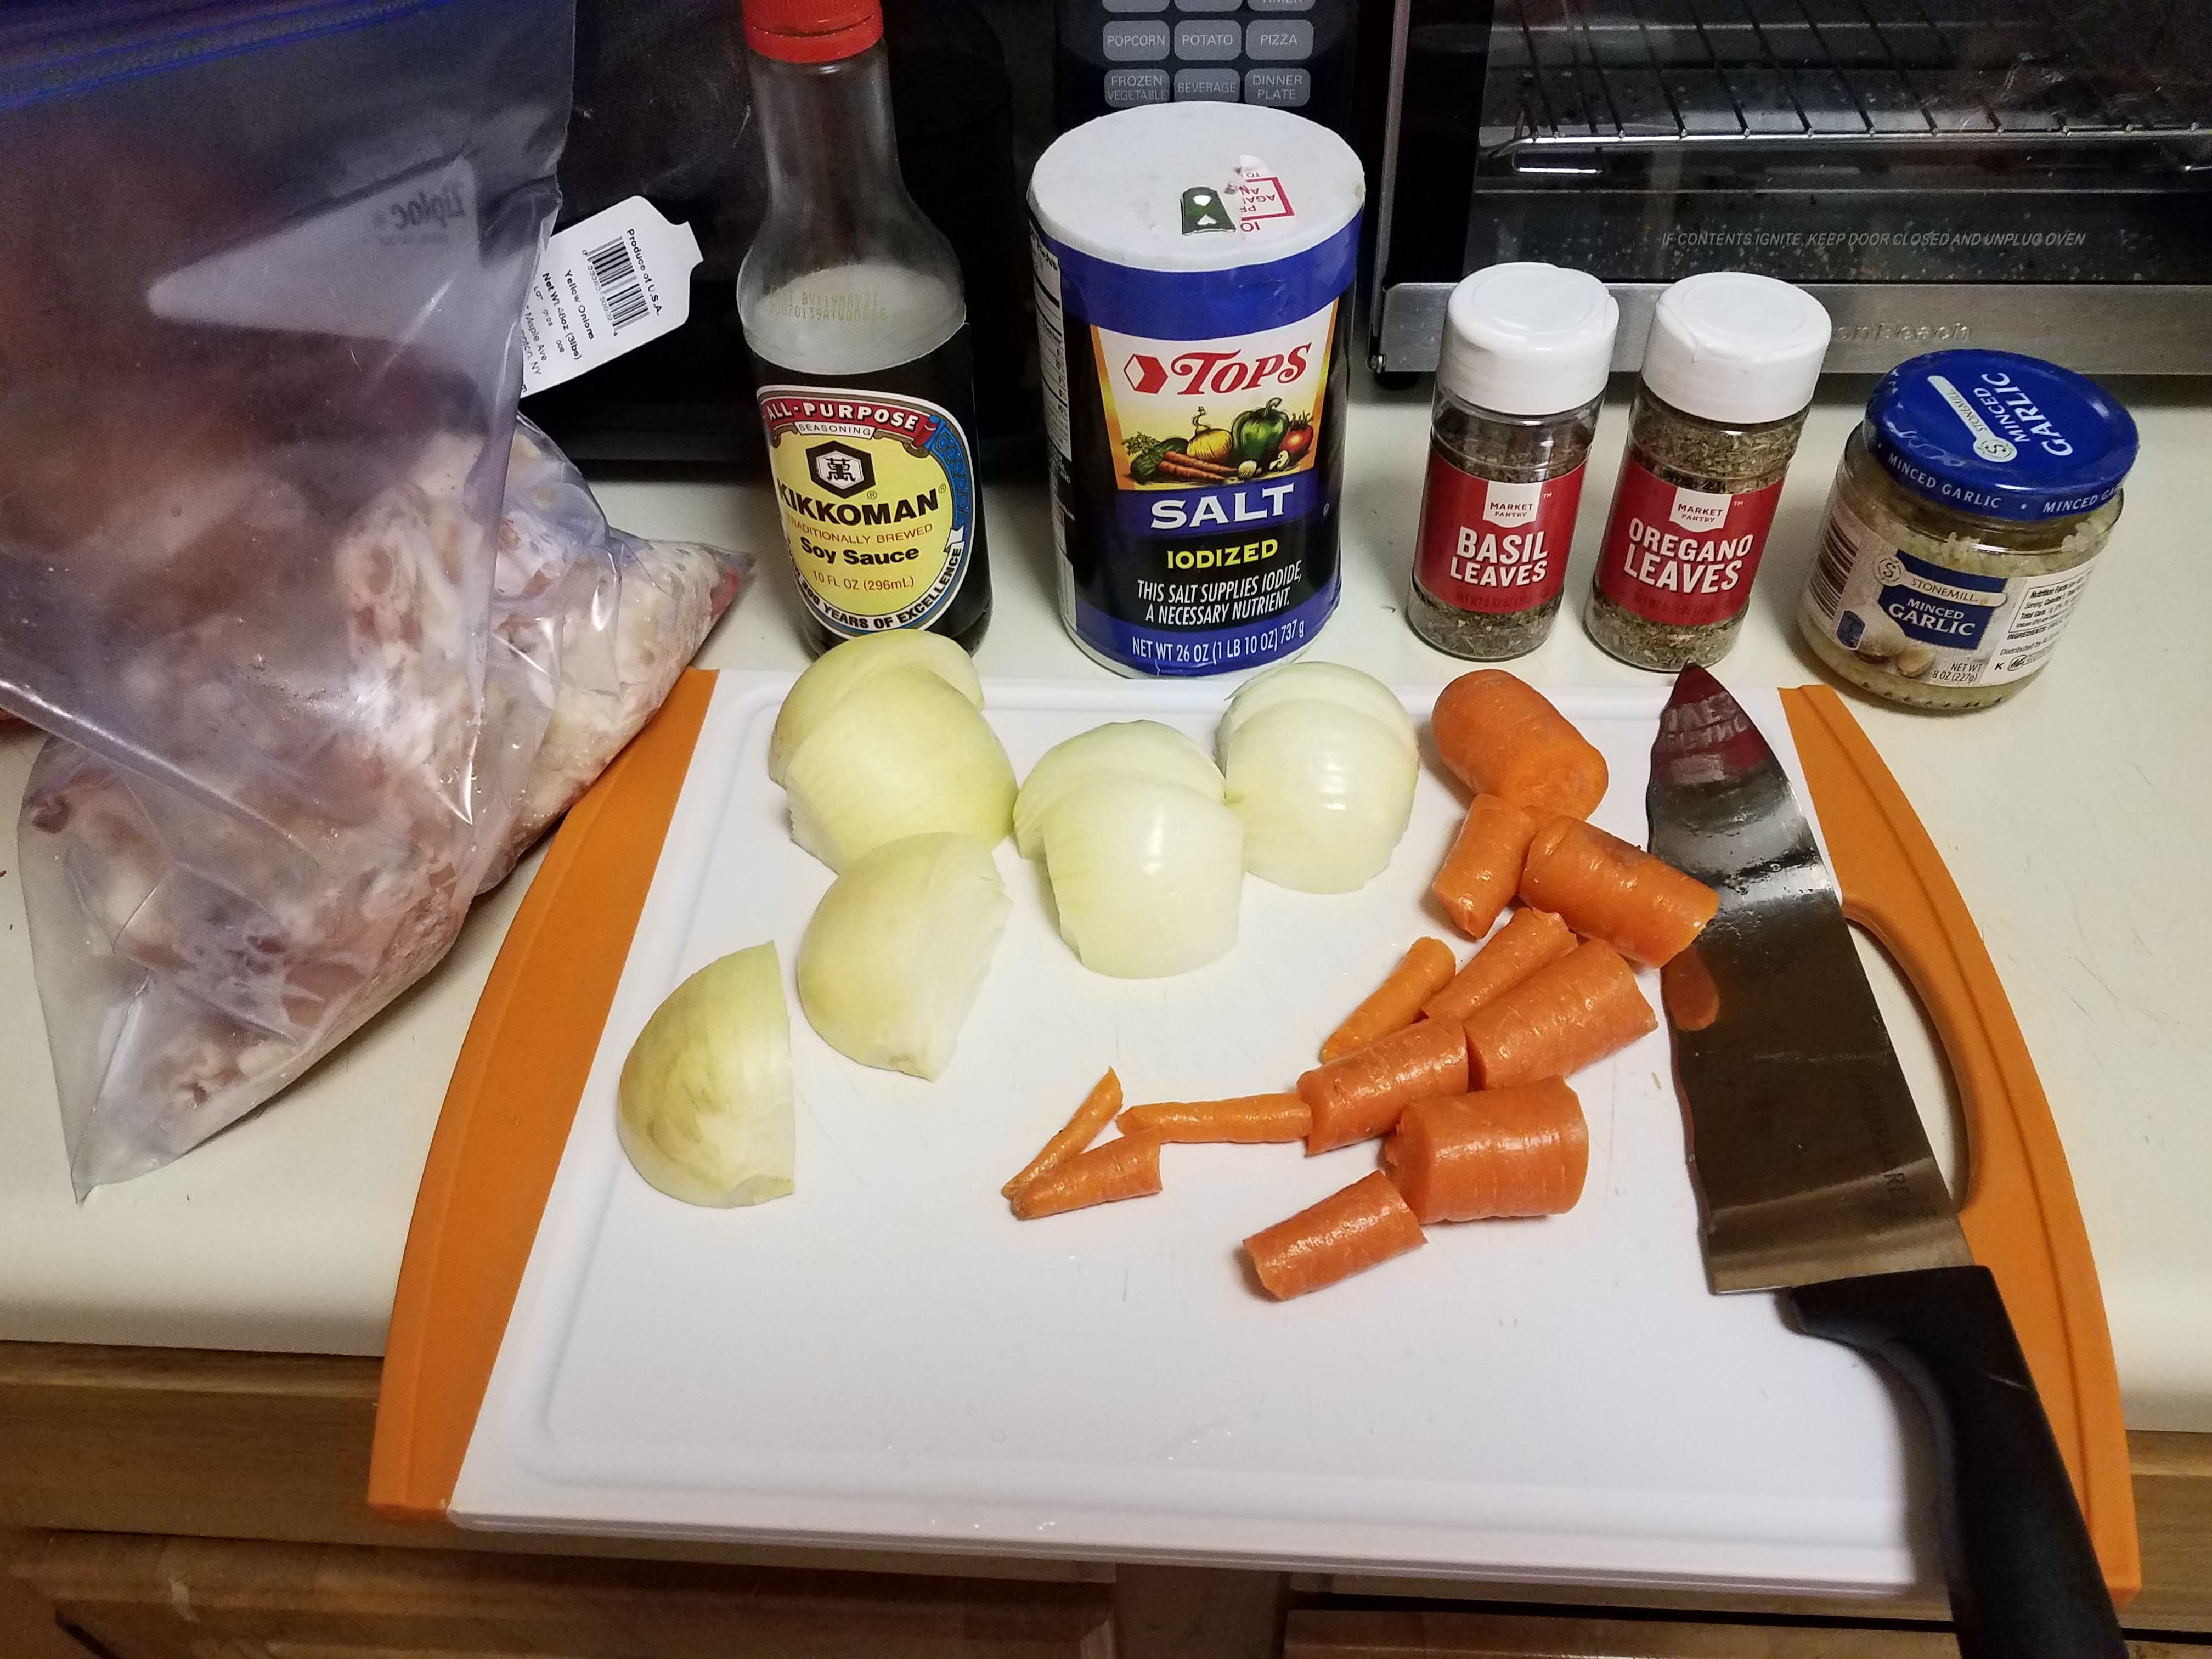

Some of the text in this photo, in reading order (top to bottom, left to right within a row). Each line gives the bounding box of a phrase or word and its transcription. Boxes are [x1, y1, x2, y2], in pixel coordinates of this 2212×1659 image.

[1108, 35, 1165, 46] POPCORN
[1182, 35, 1233, 45] POTATO
[1260, 34, 1297, 45] PIZZA
[1111, 76, 1163, 86] FROZEN
[1178, 82, 1236, 93] BEVERAGE
[1252, 75, 1302, 86] DINNER
[1257, 89, 1296, 100] PLATE
[1107, 89, 1167, 101] VEGETABLE
[1662, 232, 2085, 247] IF CONTENTS IGNITE, KEEP DOOR CLOSED AND UNPLUG OVEN
[627, 228, 662, 316] Produce of U.S.A.
[543, 272, 582, 360] Net Wt 48oz (3lbs)
[565, 270, 594, 340] Yellow Onions
[524, 312, 547, 360] Maple Ave
[531, 362, 541, 375] NY
[766, 402, 919, 430] ALL-PURPOSE
[1973, 387, 2030, 442] MINCED
[1980, 372, 2073, 456] GARLIC
[798, 423, 871, 436] SEASONING
[1888, 452, 2002, 509] MINCED GARLIC
[777, 478, 939, 526] KIKKOMAN
[1150, 482, 1294, 529] SALT
[1490, 502, 1534, 511] MARKET
[1678, 504, 1723, 517] MARKET
[2042, 495, 2098, 514] MINCED
[786, 513, 933, 544] TRADITIONALLY BREWED
[1681, 514, 1715, 522] PANTRY
[800, 537, 836, 565] Soy
[844, 548, 919, 565] Sauce
[1457, 526, 1548, 565] BASIL
[1629, 517, 1753, 562] OREGANO
[1167, 539, 1278, 569] IODIZED
[1624, 543, 1742, 593] LEAVES
[813, 570, 915, 591] 10 FL OZ (296mL)
[1138, 560, 1302, 603] THIS SALT SUPPLIES IODIDE,
[1450, 556, 1548, 587] LEAVES
[823, 603, 869, 629] YEARS
[873, 616, 894, 629] OF
[898, 548, 961, 625] EXCELLENCE
[1911, 578, 1977, 602] STONEMILL
[1146, 587, 1290, 625] A NECESSARY NUTRIENT.
[1888, 603, 1976, 636] GARLIC
[1907, 598, 1965, 619] MINCED
[1132, 619, 1305, 664] NET WT 26 OZ (1 LB 10 OZ) 737 g
[2000, 644, 2034, 656] Distributed
[1932, 670, 1978, 683] 8 OZ (227g)
[1951, 663, 1983, 672] NET WT
